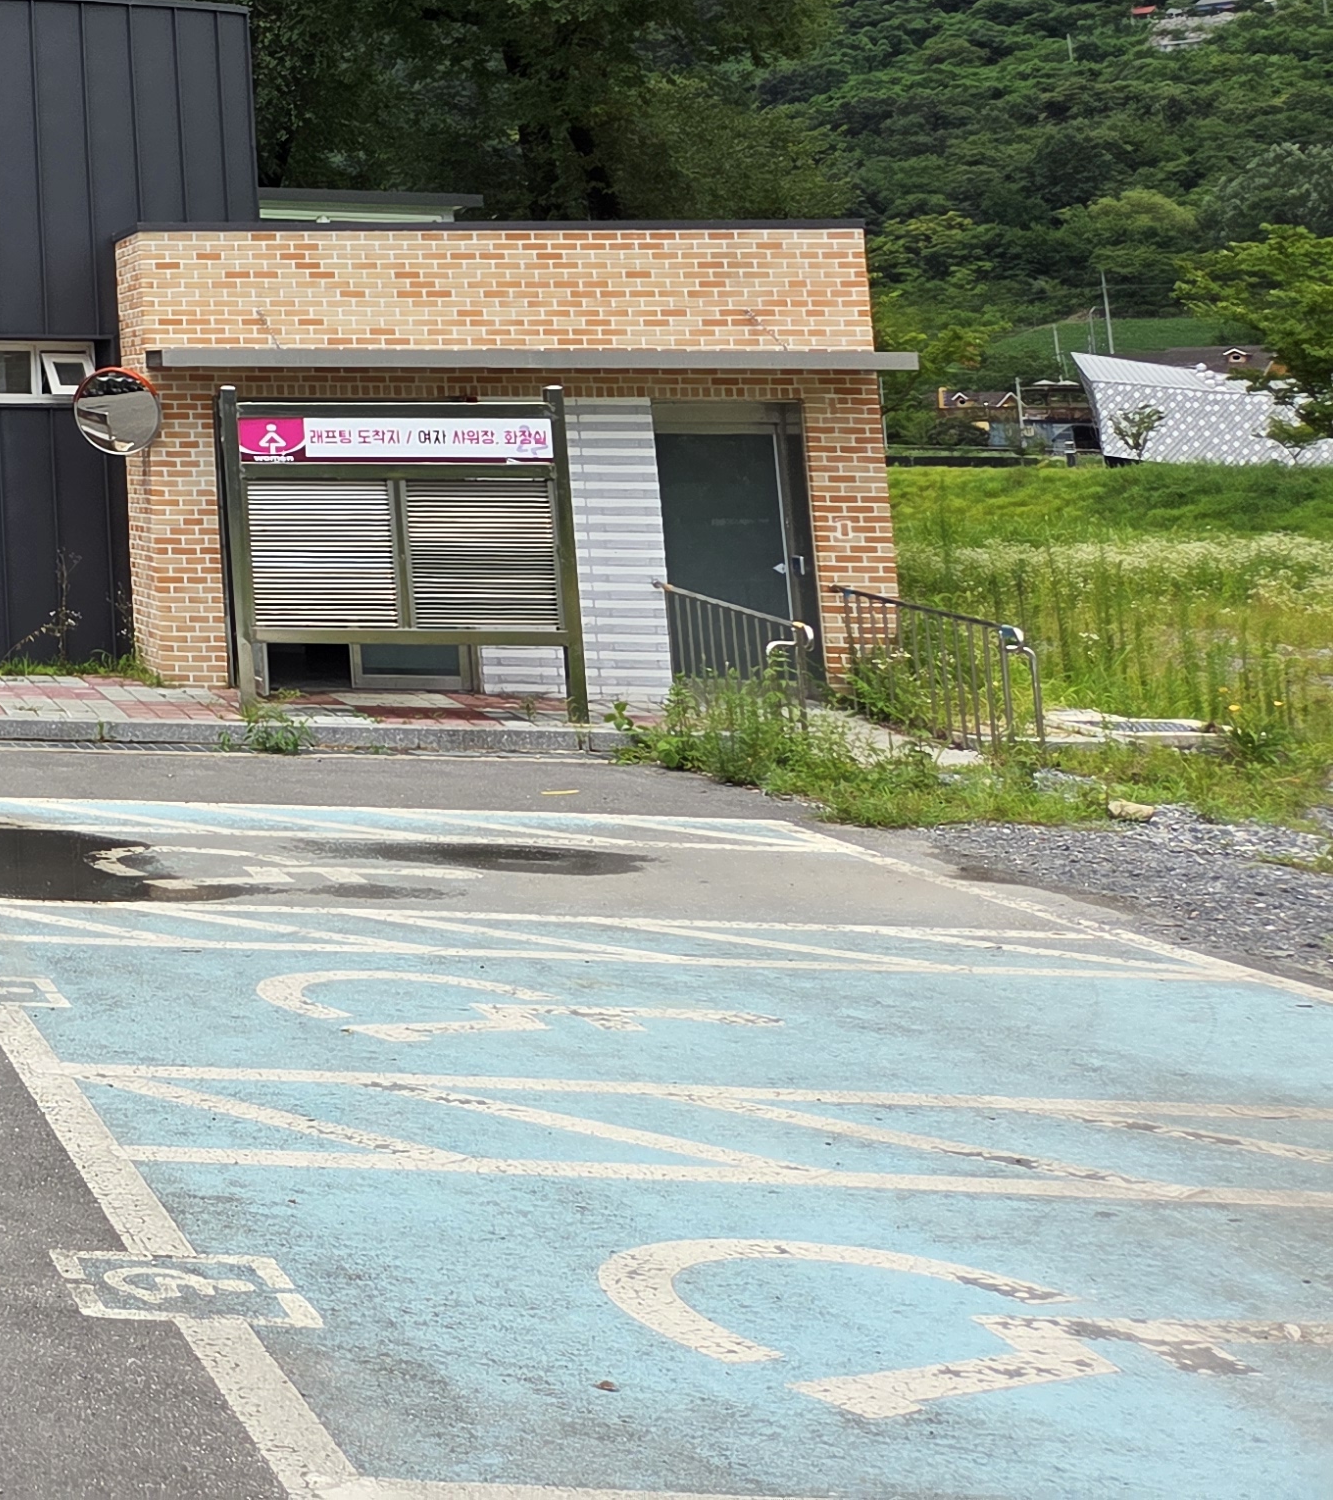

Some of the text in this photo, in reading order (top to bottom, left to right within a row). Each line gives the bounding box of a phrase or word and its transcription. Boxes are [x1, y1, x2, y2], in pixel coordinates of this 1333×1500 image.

[310, 429, 352, 444] 래프팅
[358, 429, 400, 444] 도착지
[418, 430, 446, 444] 여자
[504, 430, 547, 445] 화장실
